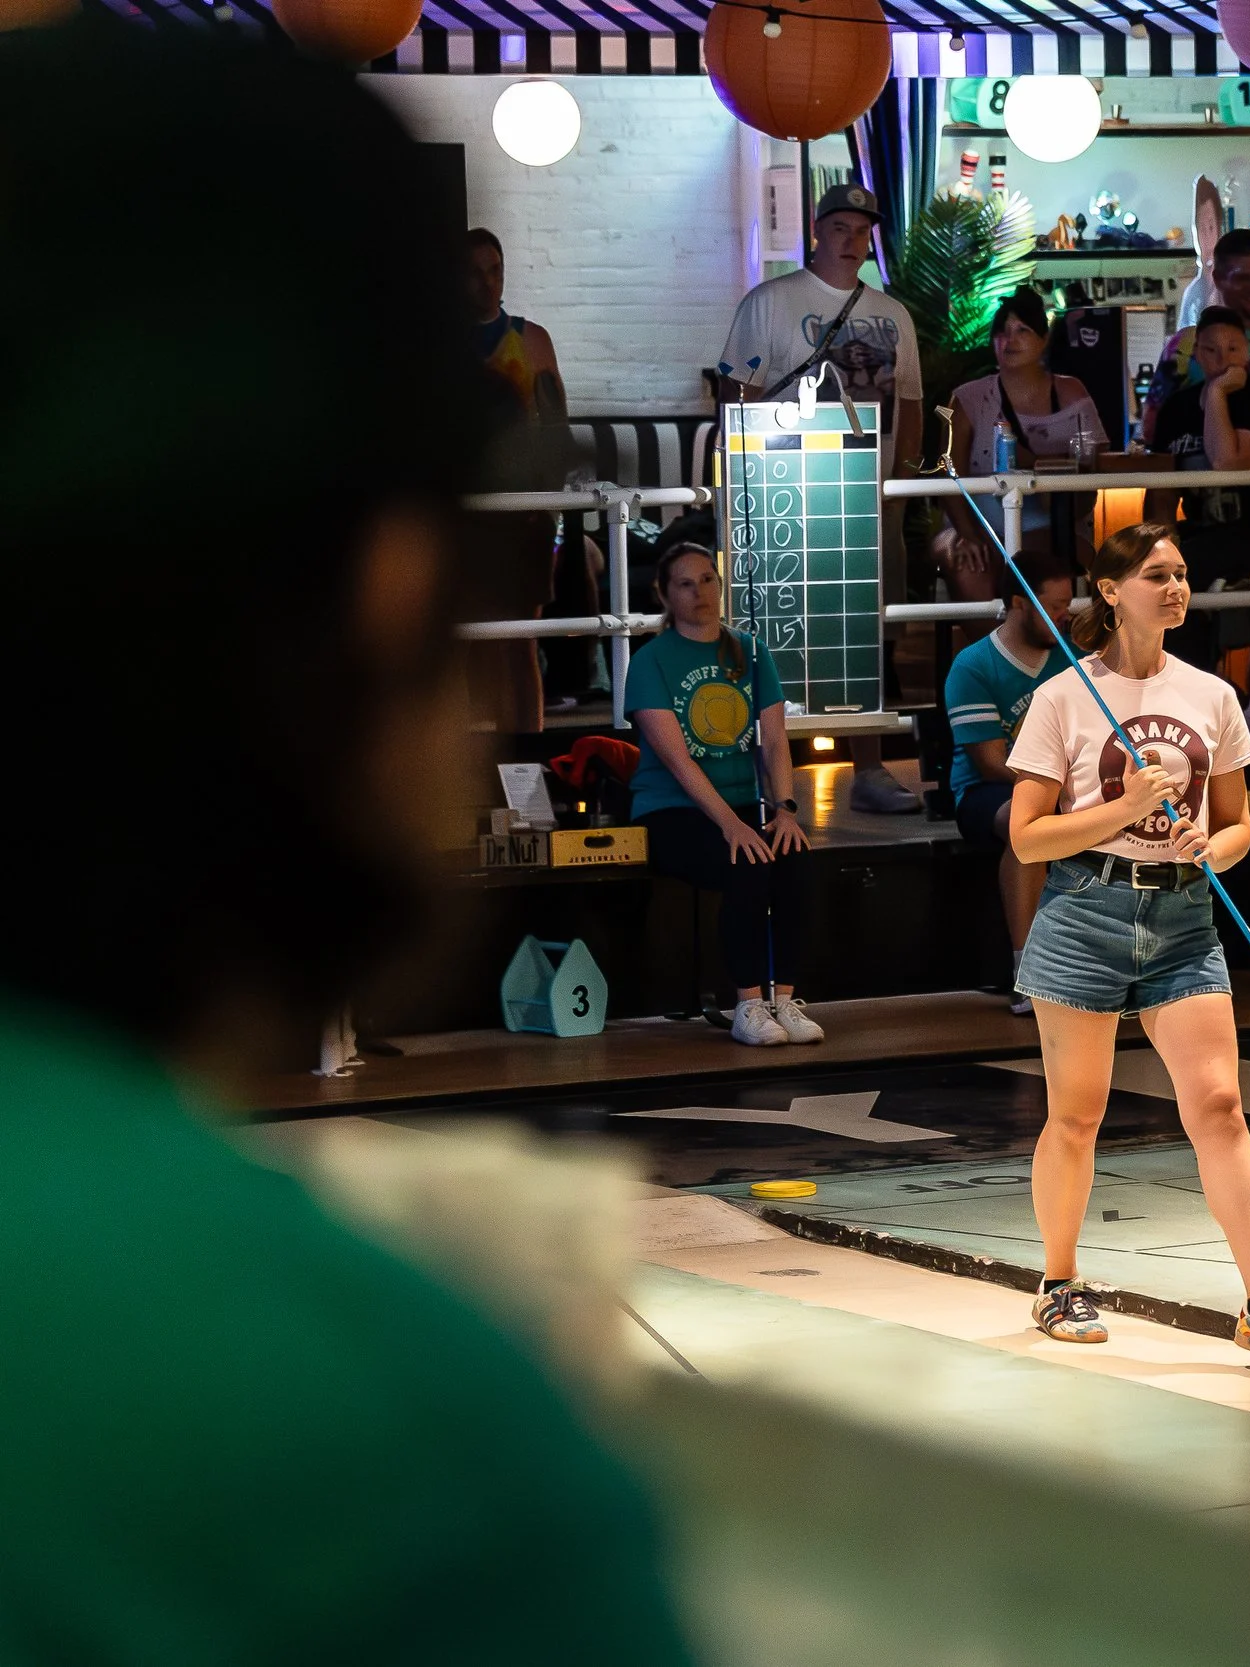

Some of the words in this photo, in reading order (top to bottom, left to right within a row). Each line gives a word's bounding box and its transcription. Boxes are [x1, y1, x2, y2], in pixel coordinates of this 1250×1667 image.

[989, 79, 1010, 115] 8
[773, 460, 788, 479] 0
[772, 490, 793, 516] 0
[773, 521, 792, 546] 0
[773, 552, 800, 584] 0
[778, 585, 796, 609] 8
[775, 617, 803, 650] 15
[508, 835, 539, 865] Nut
[571, 984, 590, 1018] 3
